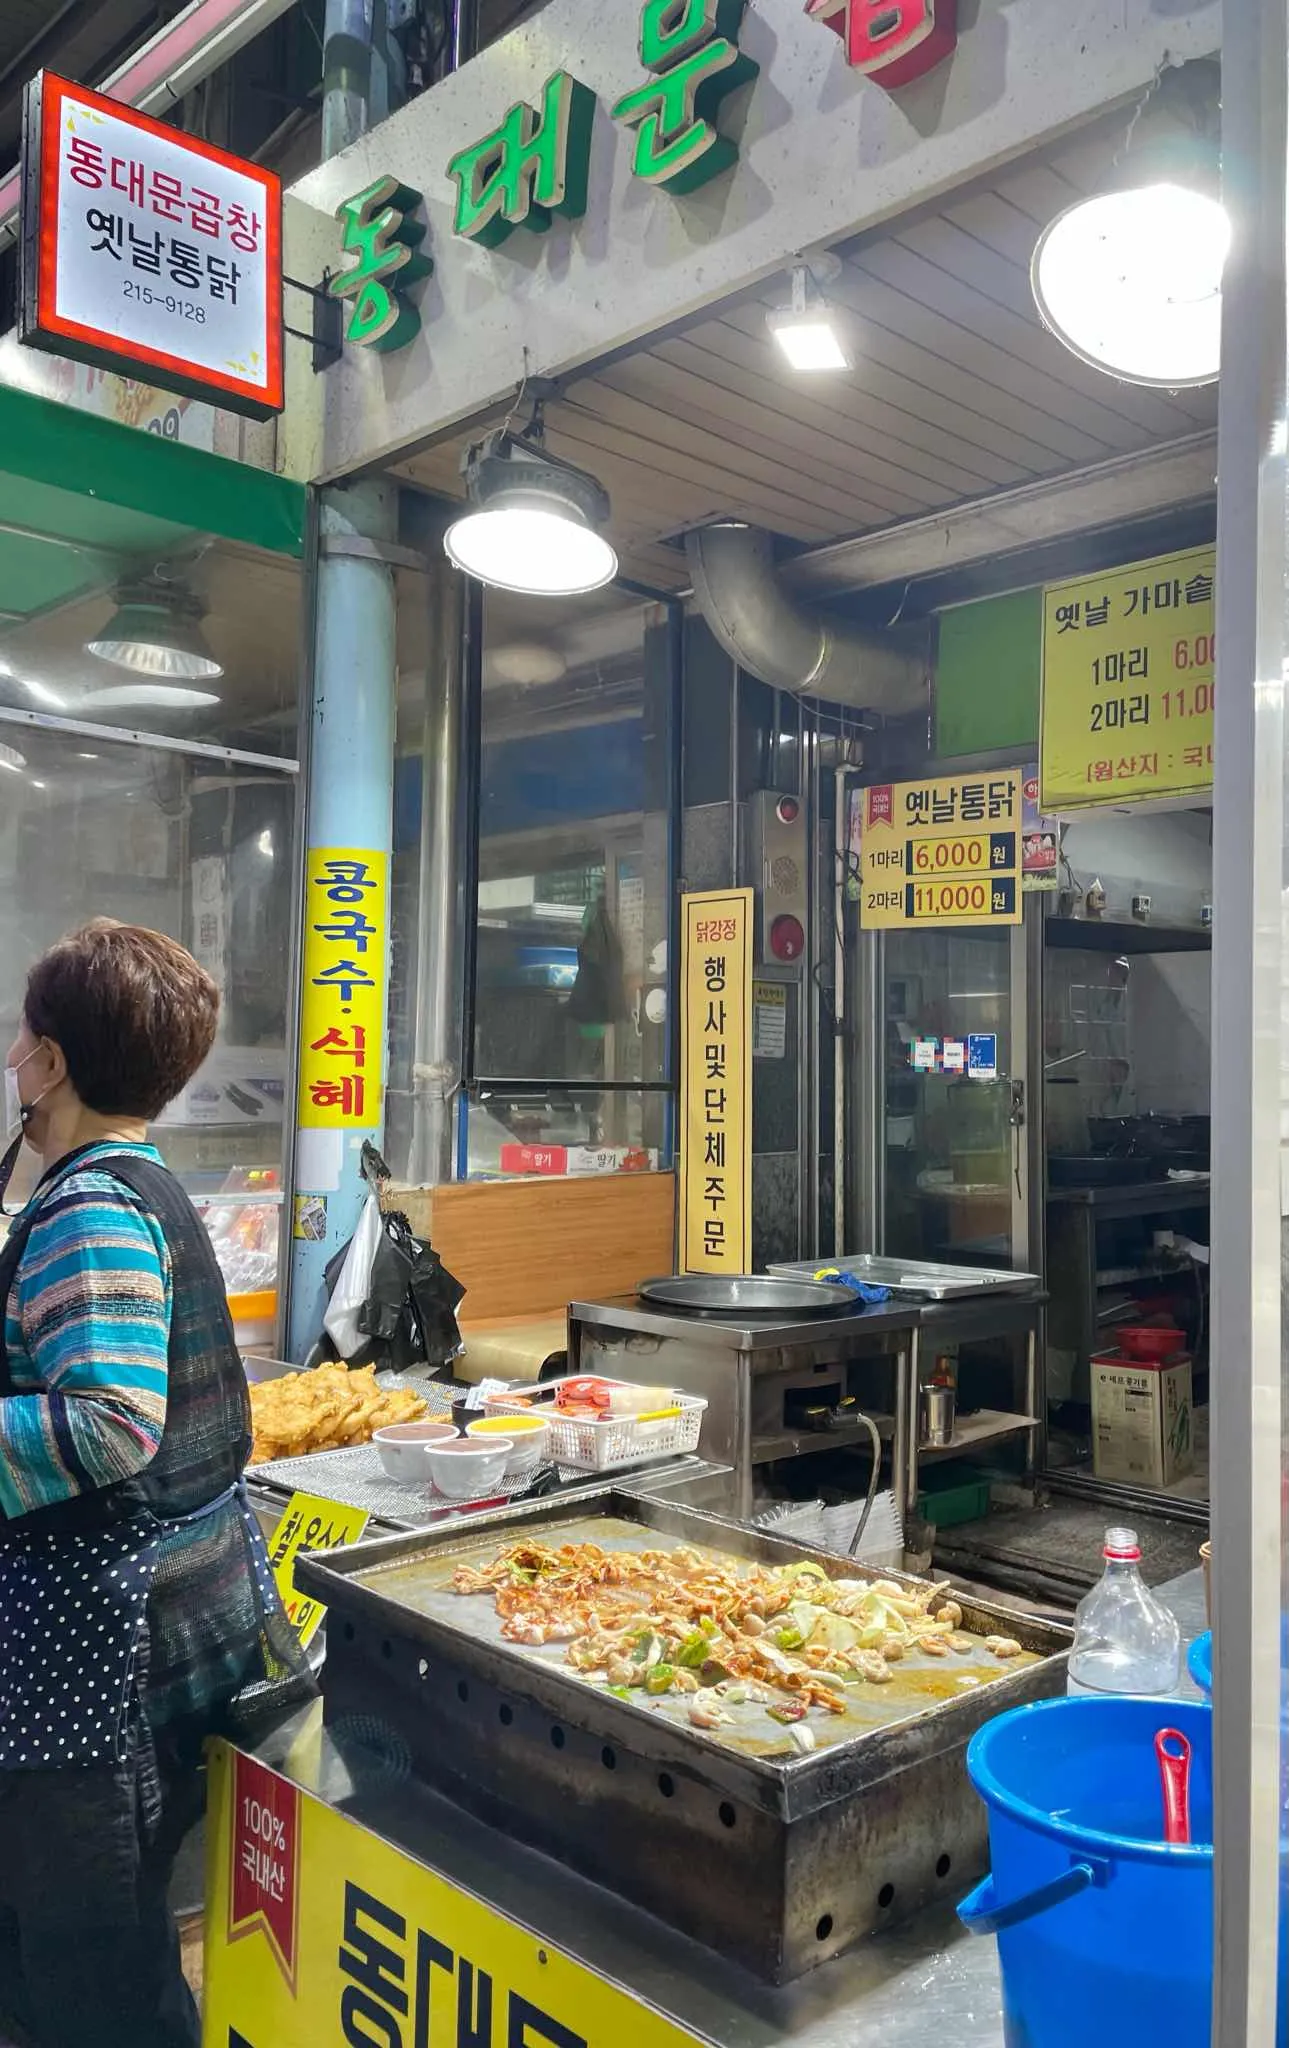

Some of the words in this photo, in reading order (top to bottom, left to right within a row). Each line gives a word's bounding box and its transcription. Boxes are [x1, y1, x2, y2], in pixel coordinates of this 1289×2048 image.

[66, 136, 262, 254] 동대문곱창
[86, 208, 242, 306] 옛날통닭
[123, 280, 207, 325] 215-9128
[1055, 596, 1111, 635] 옛날
[1091, 646, 1150, 687] 1마리
[1090, 693, 1151, 733] 2마리
[906, 781, 1016, 827] 옛날통닭
[869, 850, 904, 869] 1마리
[915, 841, 982, 871] 6,000
[992, 846, 1006, 865] 원
[867, 891, 904, 910] 2마리
[914, 885, 985, 914] 11,000
[992, 892, 1006, 911] 원
[696, 918, 737, 944] 닭강정
[243, 1797, 286, 1851] 100%
[242, 1840, 286, 1904] 국내산
